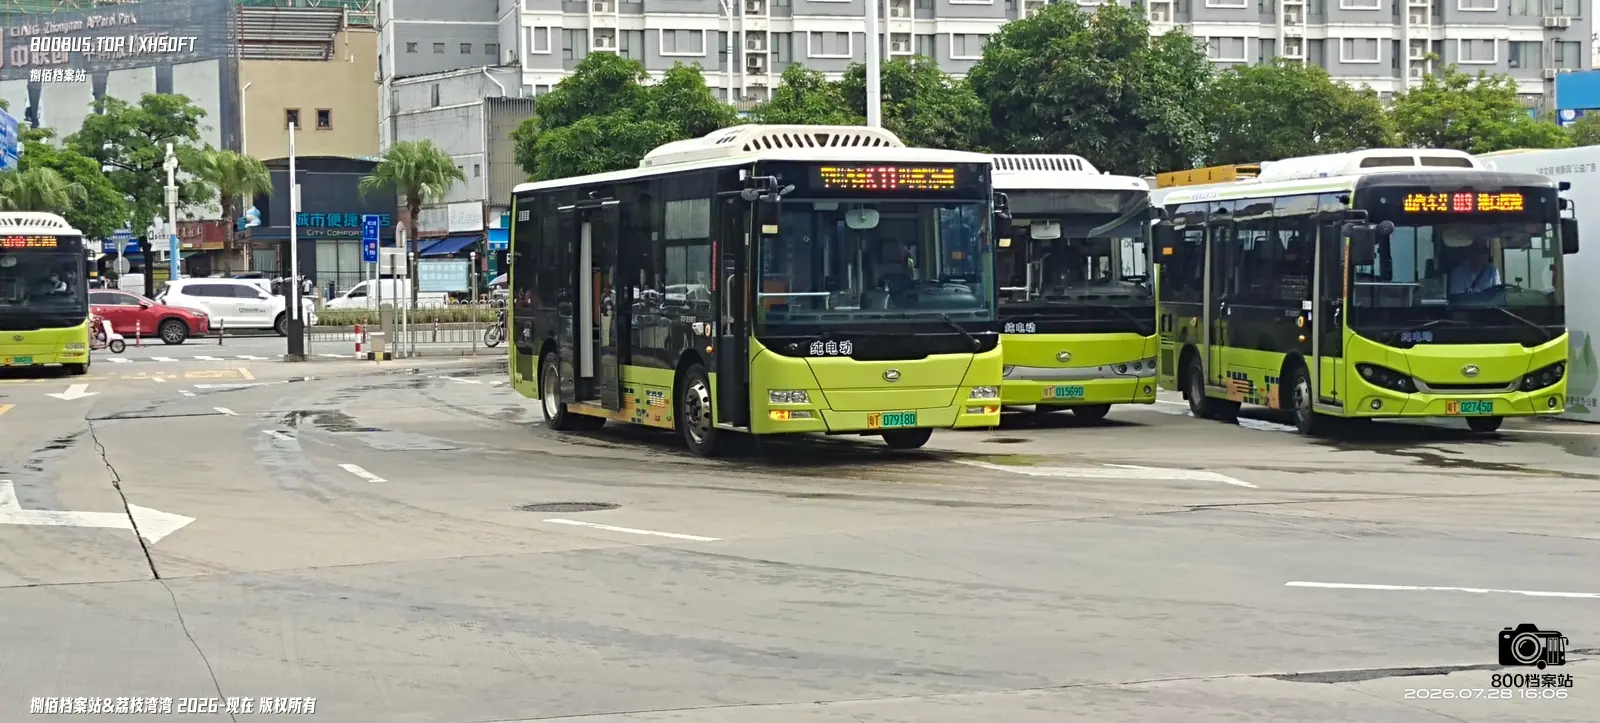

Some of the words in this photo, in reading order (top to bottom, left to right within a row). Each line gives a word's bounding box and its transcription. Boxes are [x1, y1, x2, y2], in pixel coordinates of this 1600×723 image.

[118, 12, 137, 24] Park
[296, 213, 391, 227] 城市便捷店
[1004, 322, 1036, 333] 纯电动
[810, 340, 853, 355] 纯电动
[1055, 386, 1084, 397] 01569D
[1460, 401, 1493, 412] 02745D
[883, 412, 916, 426] 07918D
